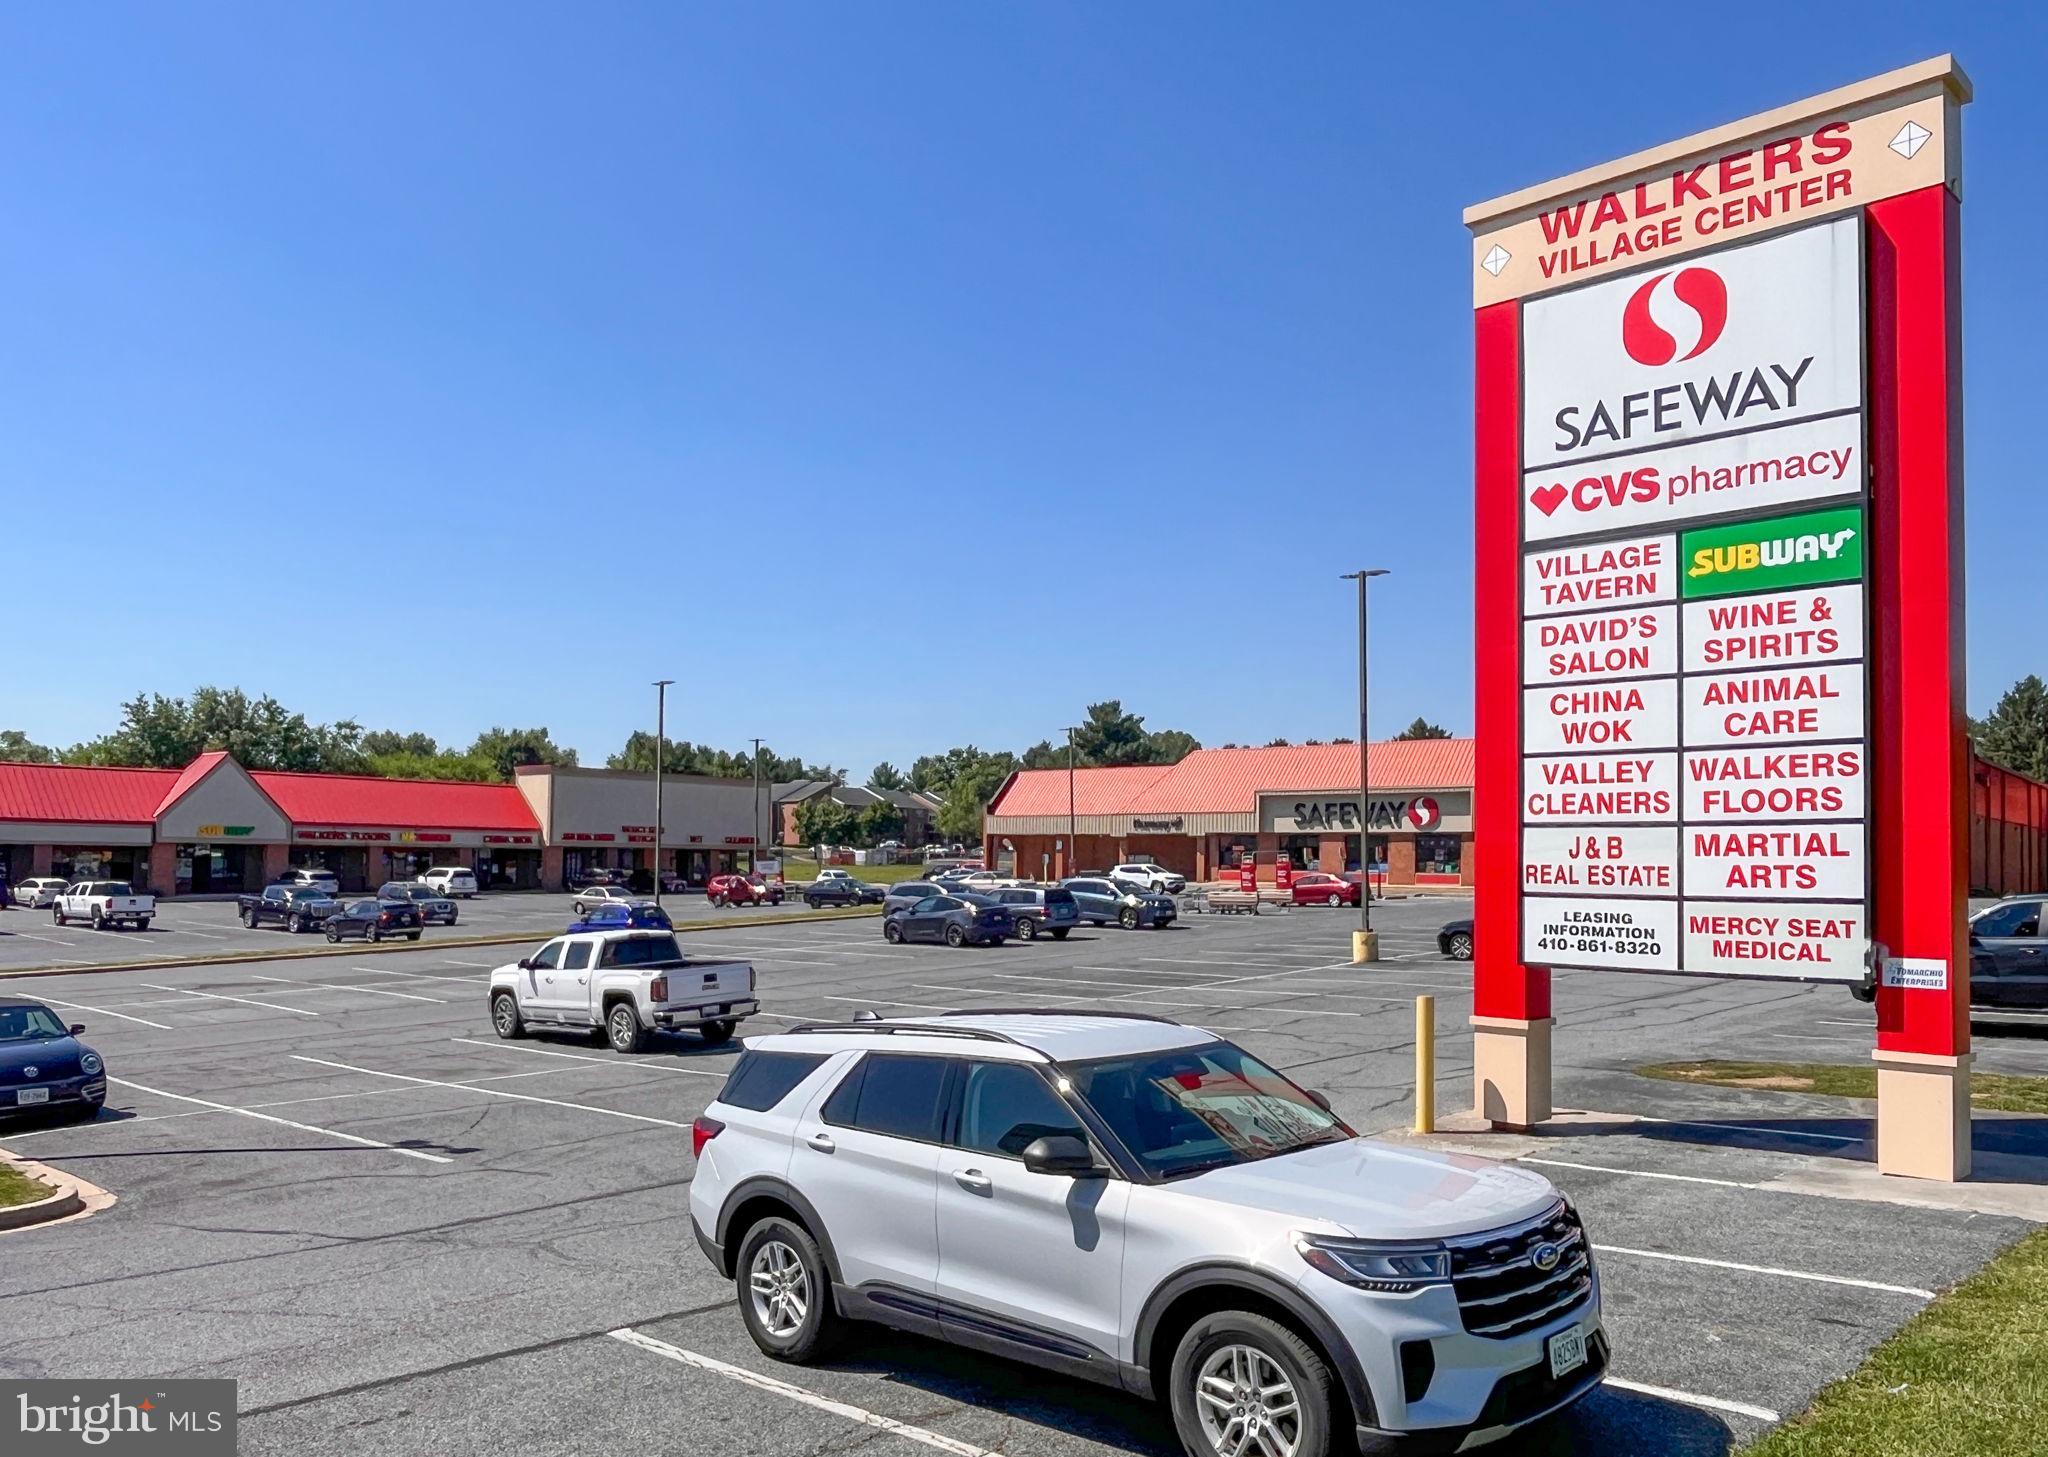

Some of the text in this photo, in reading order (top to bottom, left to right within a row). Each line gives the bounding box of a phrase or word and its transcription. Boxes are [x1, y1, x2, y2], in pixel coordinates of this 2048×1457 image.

[1539, 122, 1853, 246] WALKERS
[1538, 168, 1853, 279] VILLAGE CENTER
[1555, 356, 1814, 451] SAFEWAY
[1571, 448, 1851, 513] CVS pharmacy
[1537, 543, 1660, 580] VILLAGE
[1688, 528, 1856, 578] SUBWAY
[1540, 572, 1657, 605] TAVERN
[1709, 596, 1831, 631] WINE &
[1540, 614, 1658, 648] DAVID'S
[1703, 628, 1839, 664] SPIRITS
[1549, 646, 1649, 676] SALON
[1549, 688, 1645, 716] CHINA
[1704, 674, 1840, 705] ANIMAL
[1561, 719, 1631, 745] WOK
[1723, 707, 1818, 737] CARE
[1542, 760, 1653, 785] VALLEY
[1689, 751, 1860, 782] WALKERS
[1528, 790, 1671, 816] CLEANERS
[1702, 785, 1843, 814] FLOORS
[1294, 801, 1406, 828] SAFEWAY
[1569, 835, 1623, 860] J & B
[1694, 832, 1849, 858] MARTIAL
[1525, 864, 1669, 887] REAL ESTATE
[1726, 863, 1817, 890] ARTS
[1543, 924, 1655, 940] INFORMATION
[1563, 911, 1633, 925] LEASING
[1689, 915, 1856, 938] MERCY SEAT
[1537, 937, 1661, 956] 410-861-8320
[1712, 939, 1831, 963] MEDICAL
[1890, 976, 1944, 987] ENTERPRISES
